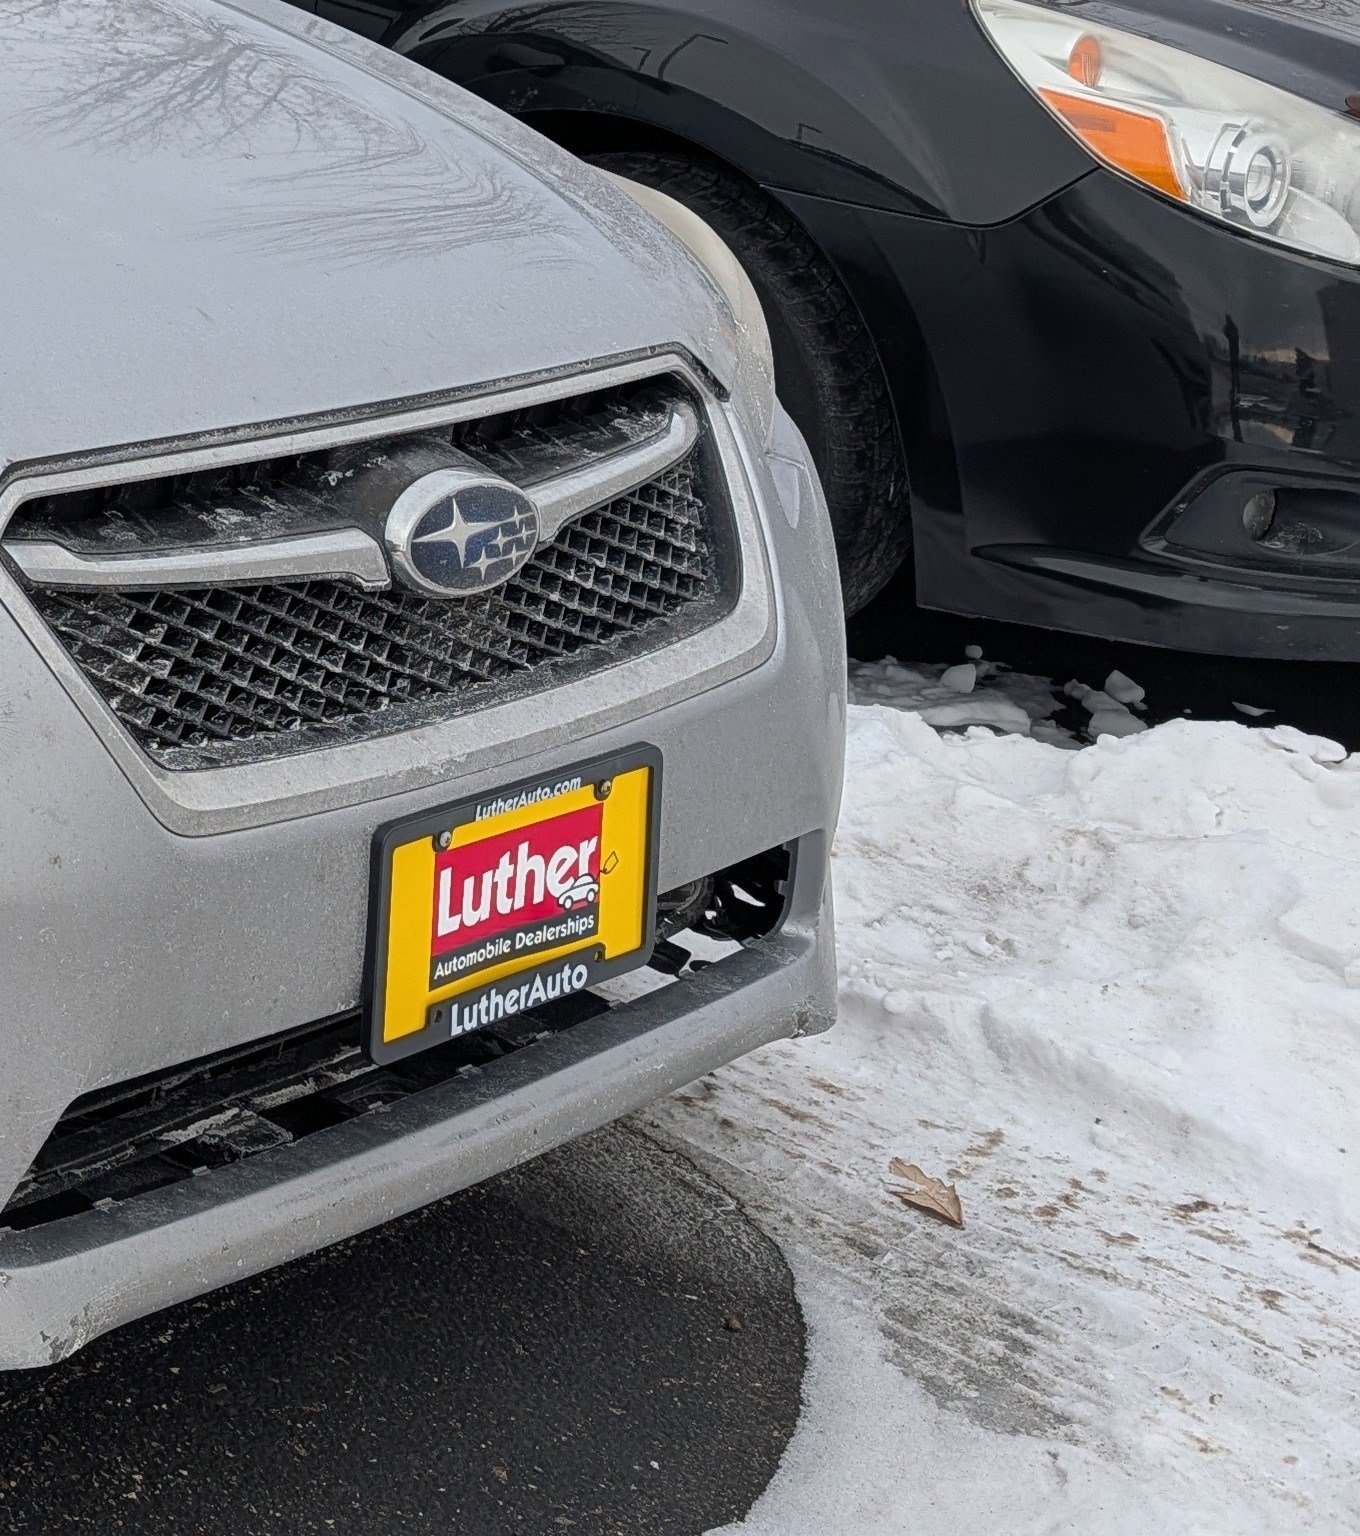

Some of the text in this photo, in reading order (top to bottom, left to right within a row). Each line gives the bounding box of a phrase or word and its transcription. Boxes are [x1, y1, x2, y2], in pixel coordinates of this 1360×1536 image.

[475, 776, 582, 822] LutherAuto.com
[437, 835, 599, 938] Luther
[433, 914, 595, 980] Automobile Dealerships
[450, 964, 588, 1037] LutherAuto
